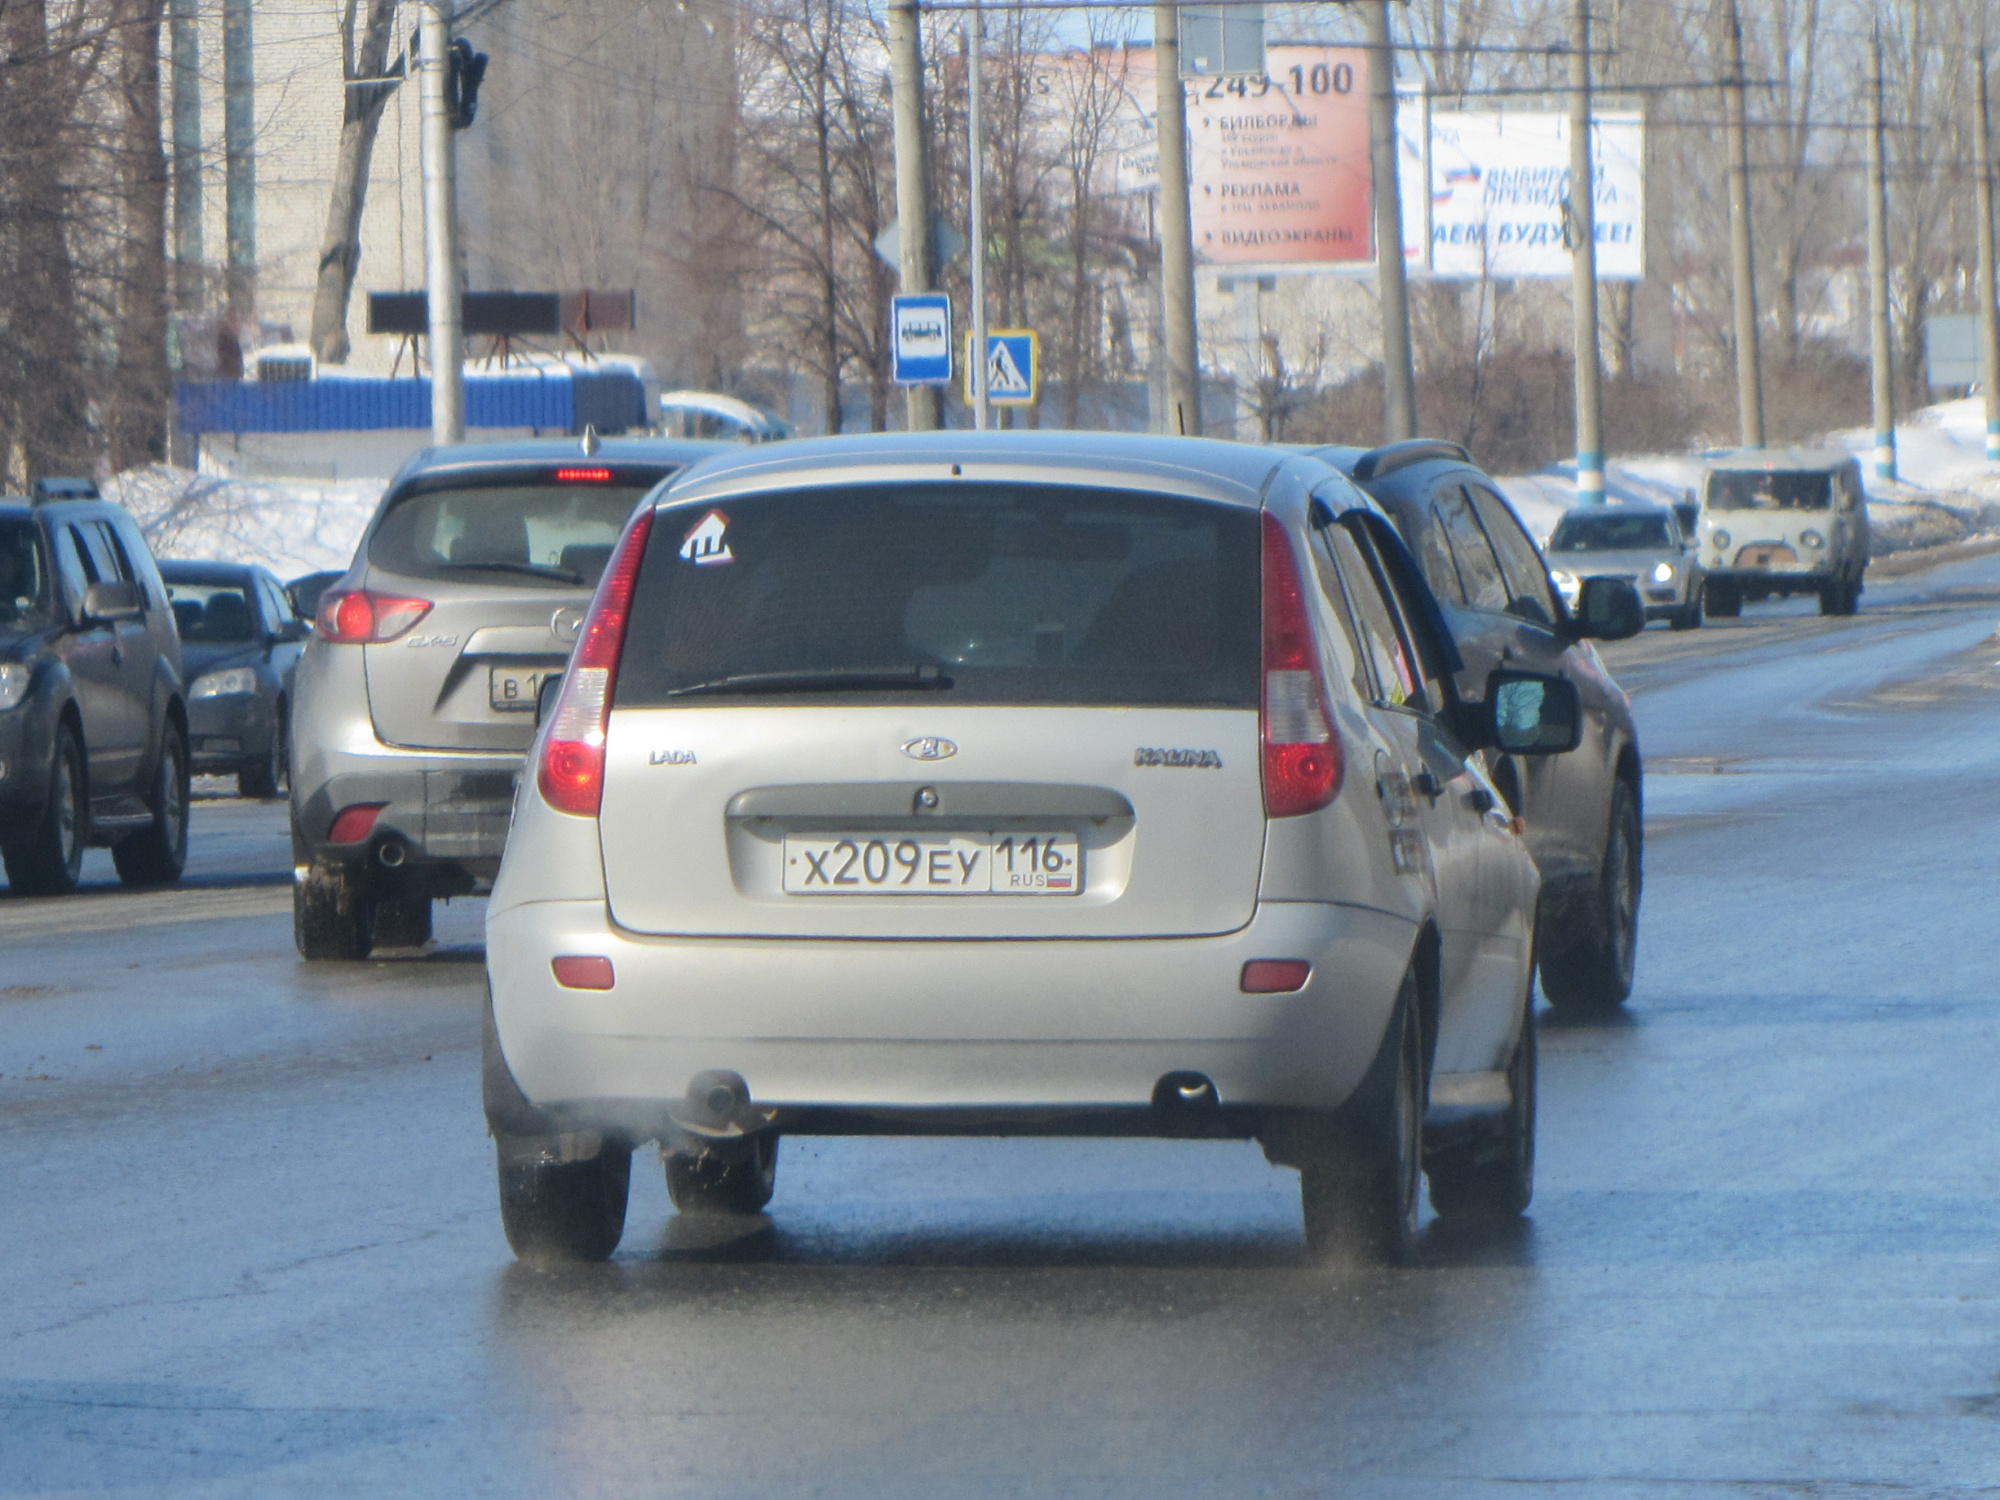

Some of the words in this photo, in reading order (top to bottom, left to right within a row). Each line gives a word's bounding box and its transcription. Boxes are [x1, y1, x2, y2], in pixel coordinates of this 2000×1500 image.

[1289, 63, 1354, 95] 100
[1221, 182, 1302, 198] РЕКЛАМА
[1499, 223, 1634, 247] БУДУЕЕ!
[649, 750, 697, 765] LADA
[1134, 747, 1222, 769] KALINA
[995, 837, 1063, 872] 116
[1010, 874, 1045, 887] RUS
